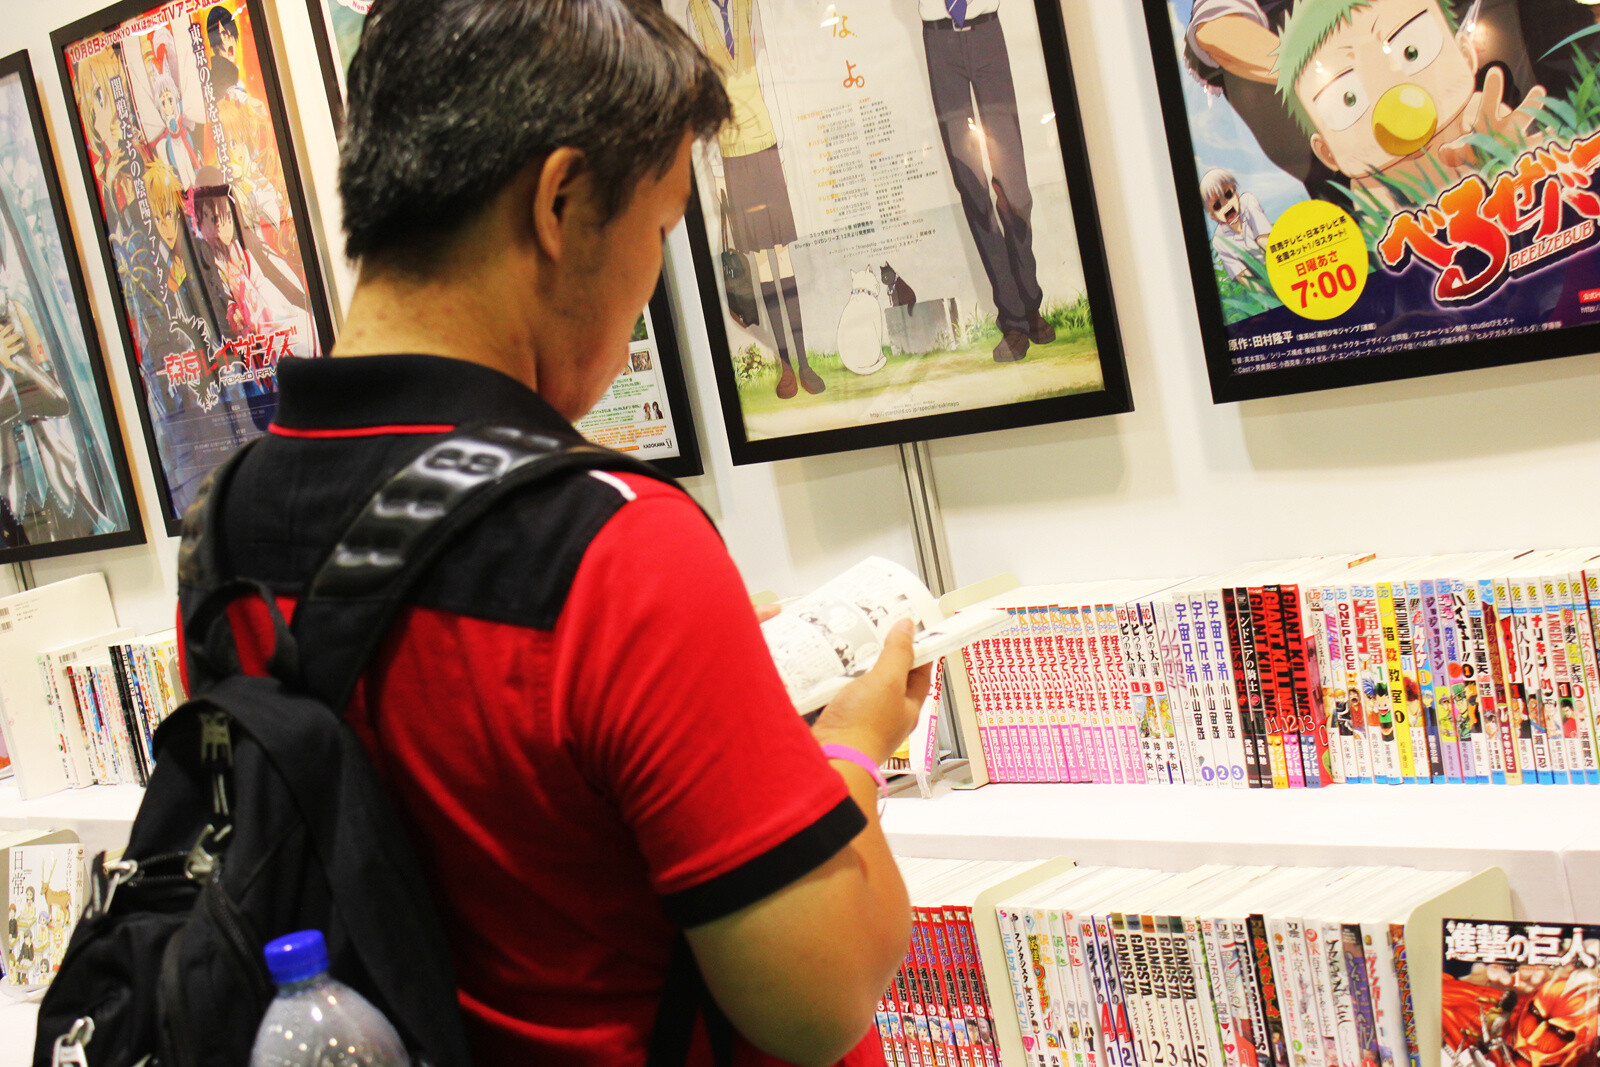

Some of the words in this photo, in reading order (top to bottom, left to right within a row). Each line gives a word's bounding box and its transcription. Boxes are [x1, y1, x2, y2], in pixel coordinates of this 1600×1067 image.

[190, 24, 236, 204] 東京の夜を羽ばたく
[1380, 131, 1600, 300] べるぜバ
[1295, 250, 1338, 277] 日曜あさ
[1509, 221, 1593, 270] BEELZEBUB
[1291, 264, 1357, 309] 7:00
[160, 326, 298, 386] 東京レイヴンズ
[257, 367, 277, 378] RAV
[1175, 603, 1198, 682] 宇宙兄弟
[1191, 601, 1213, 681] 宇宙兄弟
[1207, 600, 1229, 681] 宇宙兄弟
[1249, 594, 1268, 647] GIANT
[1338, 603, 1350, 628] ONE
[1034, 636, 1056, 713] 好きっていいなよ。
[1044, 636, 1066, 713] 好きっていいなよ。
[1055, 635, 1077, 712] 好きっていいなよ。
[1088, 636, 1110, 714] 好きっていいなよ。
[1100, 635, 1122, 713] 好きっていいなよ。
[1110, 635, 1132, 714] 好きっていいなよ。
[1160, 630, 1176, 689] ノラガミ
[1171, 629, 1187, 690] ノラガミ
[1282, 592, 1302, 646] GIANT
[1297, 714, 1316, 734] 03
[1342, 630, 1356, 670] PIECE
[1377, 666, 1383, 681] 1
[1383, 627, 1402, 704] 暗殺教室
[1516, 616, 1533, 675] 囚人リク
[1552, 648, 1568, 676] VOICE
[981, 639, 1004, 714] 好きっていいなよ。
[992, 638, 1014, 714] 好きっていいなよ。
[1002, 638, 1024, 714] 好きっていいなよ。
[1012, 638, 1034, 714] 好きっていいなよ。
[1022, 637, 1044, 714] 好きっていいなよ。
[1065, 638, 1087, 715] 好きっていいなよ。
[1075, 637, 1097, 715] 好きっていいなよ。
[1281, 715, 1299, 734] 02
[12, 850, 26, 895] 日常
[1445, 920, 1596, 968] 進撃の巨人
[1513, 971, 1520, 987] 1
[1107, 1046, 1116, 1065] 1
[1122, 1047, 1132, 1066] 2
[1137, 1039, 1148, 1062] 1
[1151, 1040, 1164, 1063] 2
[1167, 1043, 1178, 1066] 3
[1182, 1044, 1192, 1067] 4
[1197, 1045, 1208, 1067] 5
